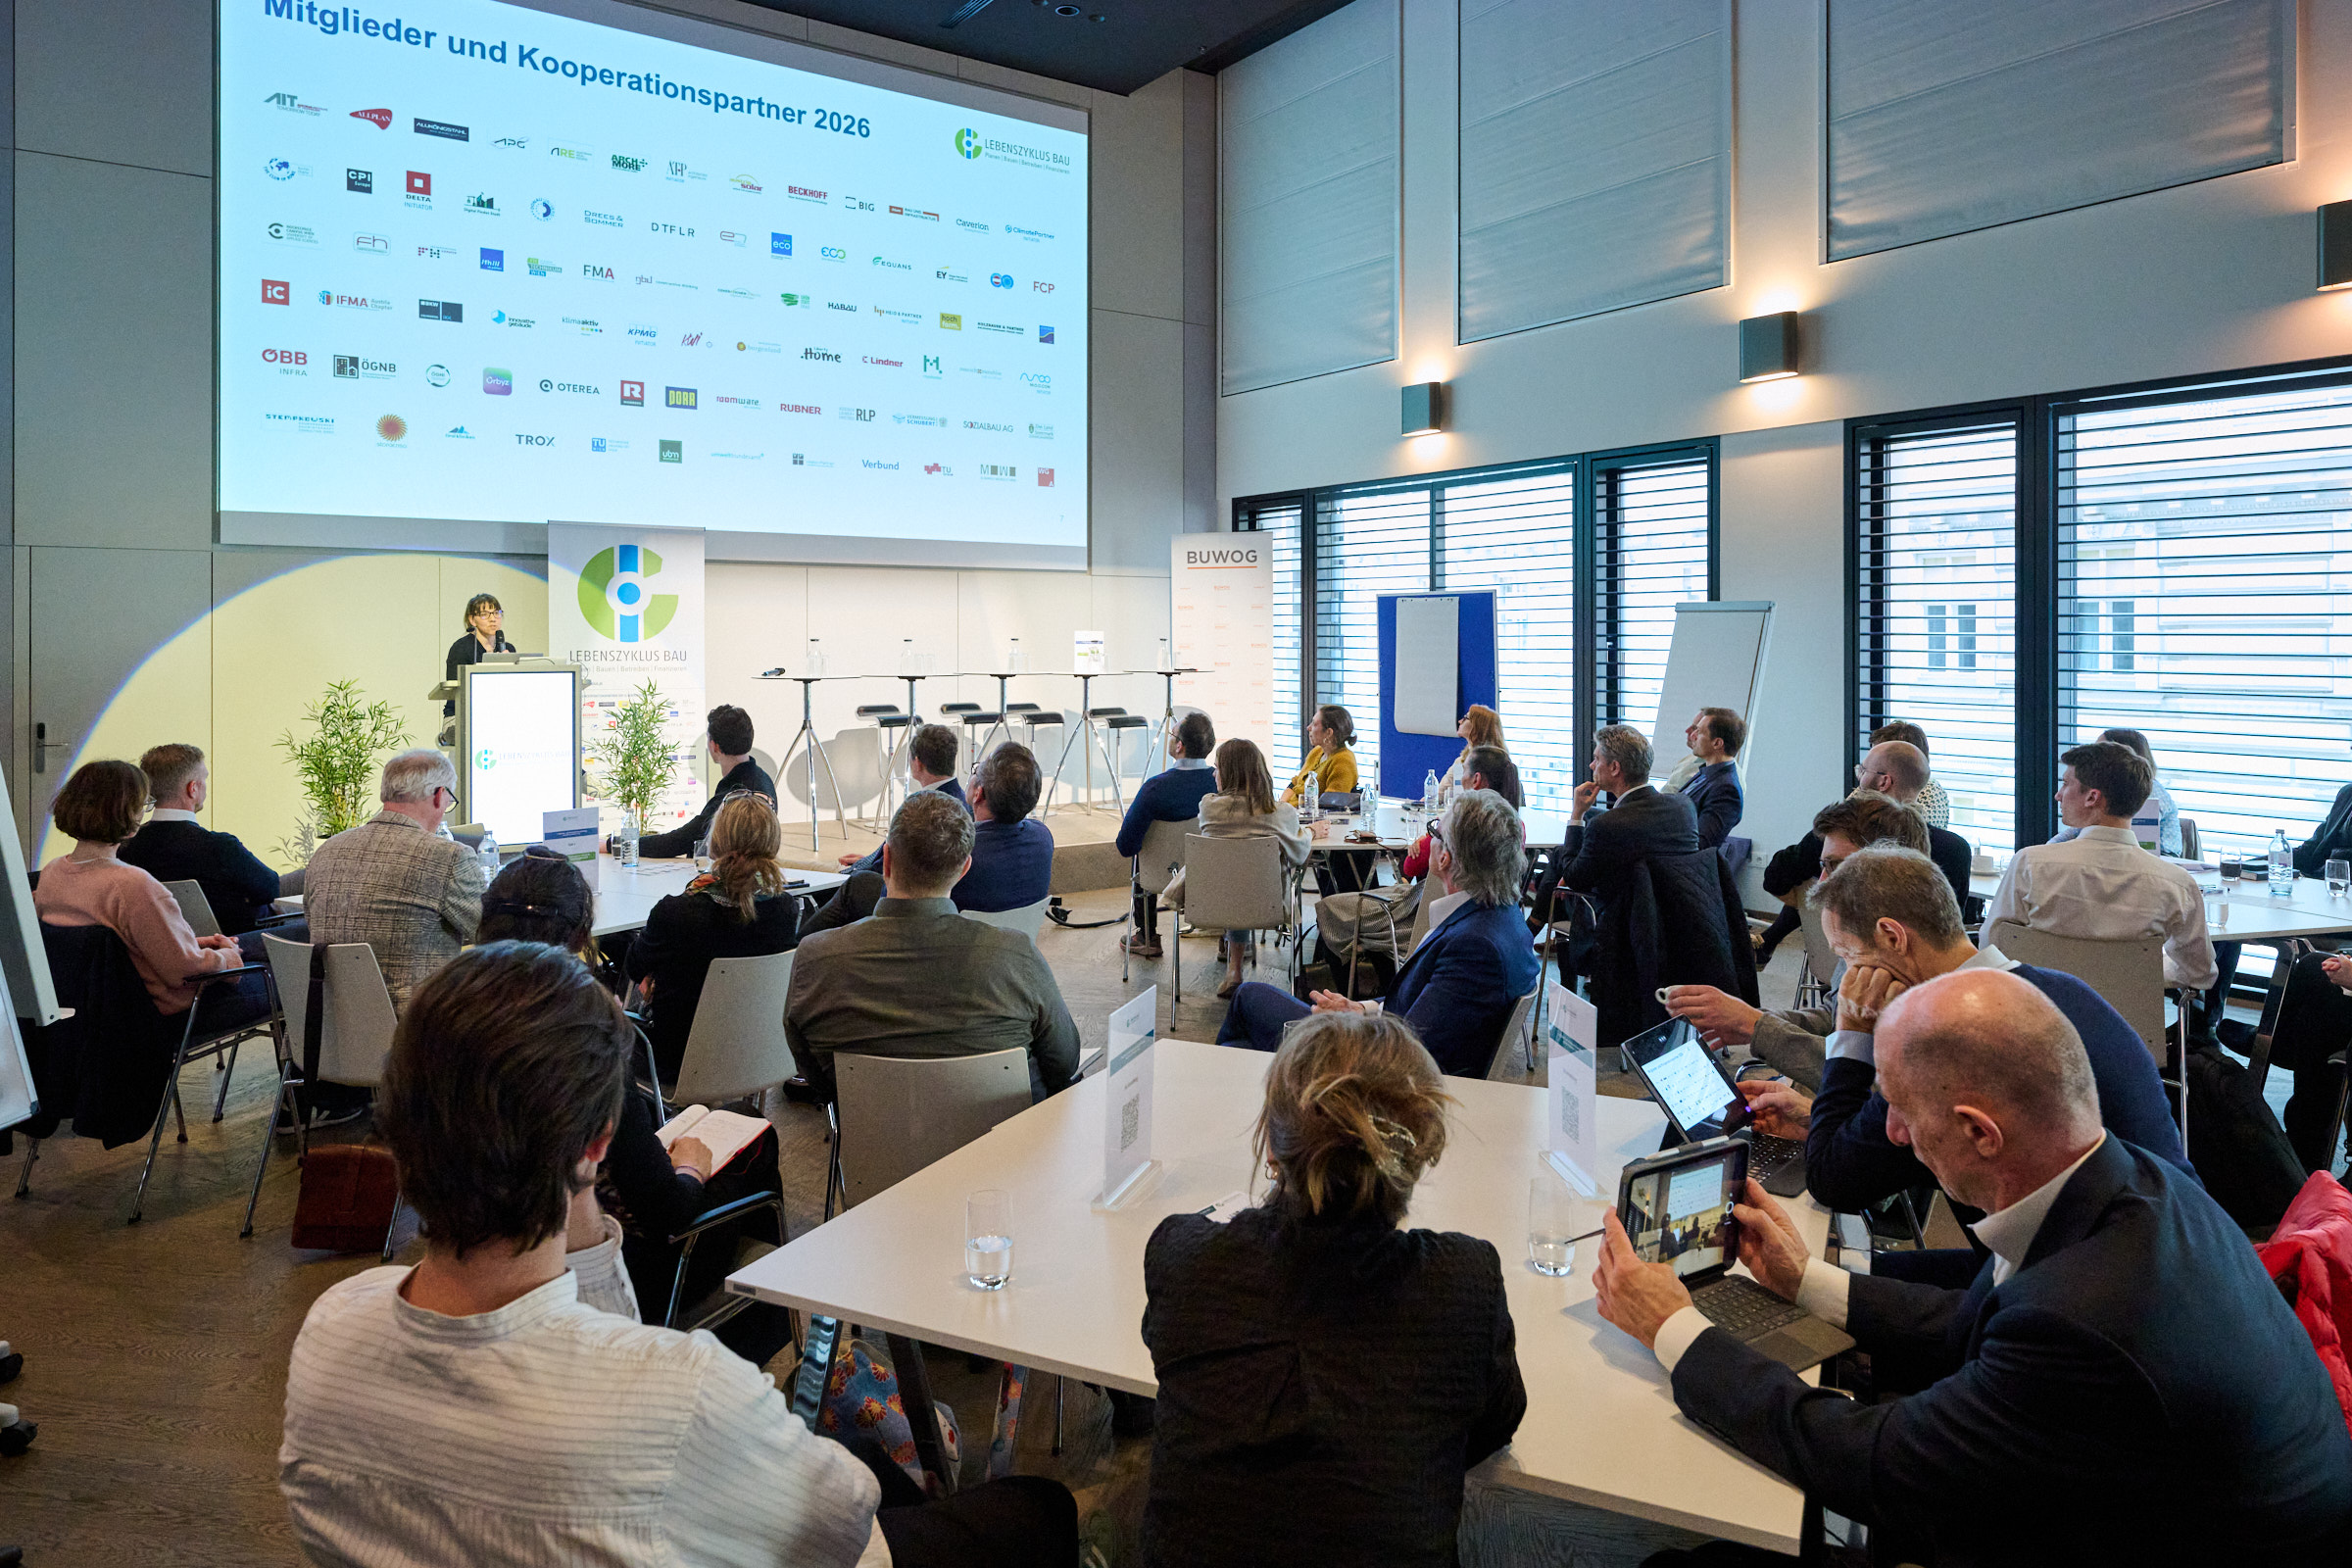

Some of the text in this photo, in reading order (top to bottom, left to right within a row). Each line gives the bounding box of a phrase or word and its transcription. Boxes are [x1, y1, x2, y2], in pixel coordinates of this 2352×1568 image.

[264, 0, 871, 139] Mitglieder und Kooperationspartner 2026
[357, 111, 391, 122] ALLPLAN
[984, 138, 1070, 166] LEBENSZYKLUS BAU
[612, 160, 642, 172] MORE
[348, 171, 371, 182] CPI
[740, 182, 762, 192] solar
[788, 185, 828, 200] BECKHOFF
[406, 194, 431, 203] DELTA
[404, 201, 433, 212] INITIATOR
[858, 201, 875, 212] BIG
[584, 210, 614, 220] DREES
[584, 217, 624, 228] SOMMER
[956, 219, 989, 231] Caverion
[1012, 226, 1054, 240] ClimatePartner
[772, 240, 791, 251] eco
[881, 260, 912, 270] EQUANS
[583, 265, 615, 280] FMA
[936, 270, 948, 279] EY
[1033, 280, 1055, 294] FCP
[336, 294, 368, 308] IFMA
[827, 301, 858, 313] HABAU
[562, 316, 600, 327] klimaaktiv
[941, 314, 957, 323] hoch
[627, 327, 658, 338] KPMG
[361, 358, 397, 373] ÖGNB
[870, 357, 904, 368] Lindner
[279, 368, 309, 377] INFRA
[557, 382, 601, 395] OTEREA
[779, 403, 822, 416] RUBNER
[856, 408, 876, 422] RLP
[962, 420, 1014, 433] SOZIALBAU AG
[514, 434, 556, 447] TROX
[592, 438, 606, 447] TU
[662, 450, 680, 459] ubm
[861, 459, 900, 470] Verbund
[1186, 549, 1258, 564] BUWOG
[568, 649, 688, 662] LEBENSZYKLUS BAU
